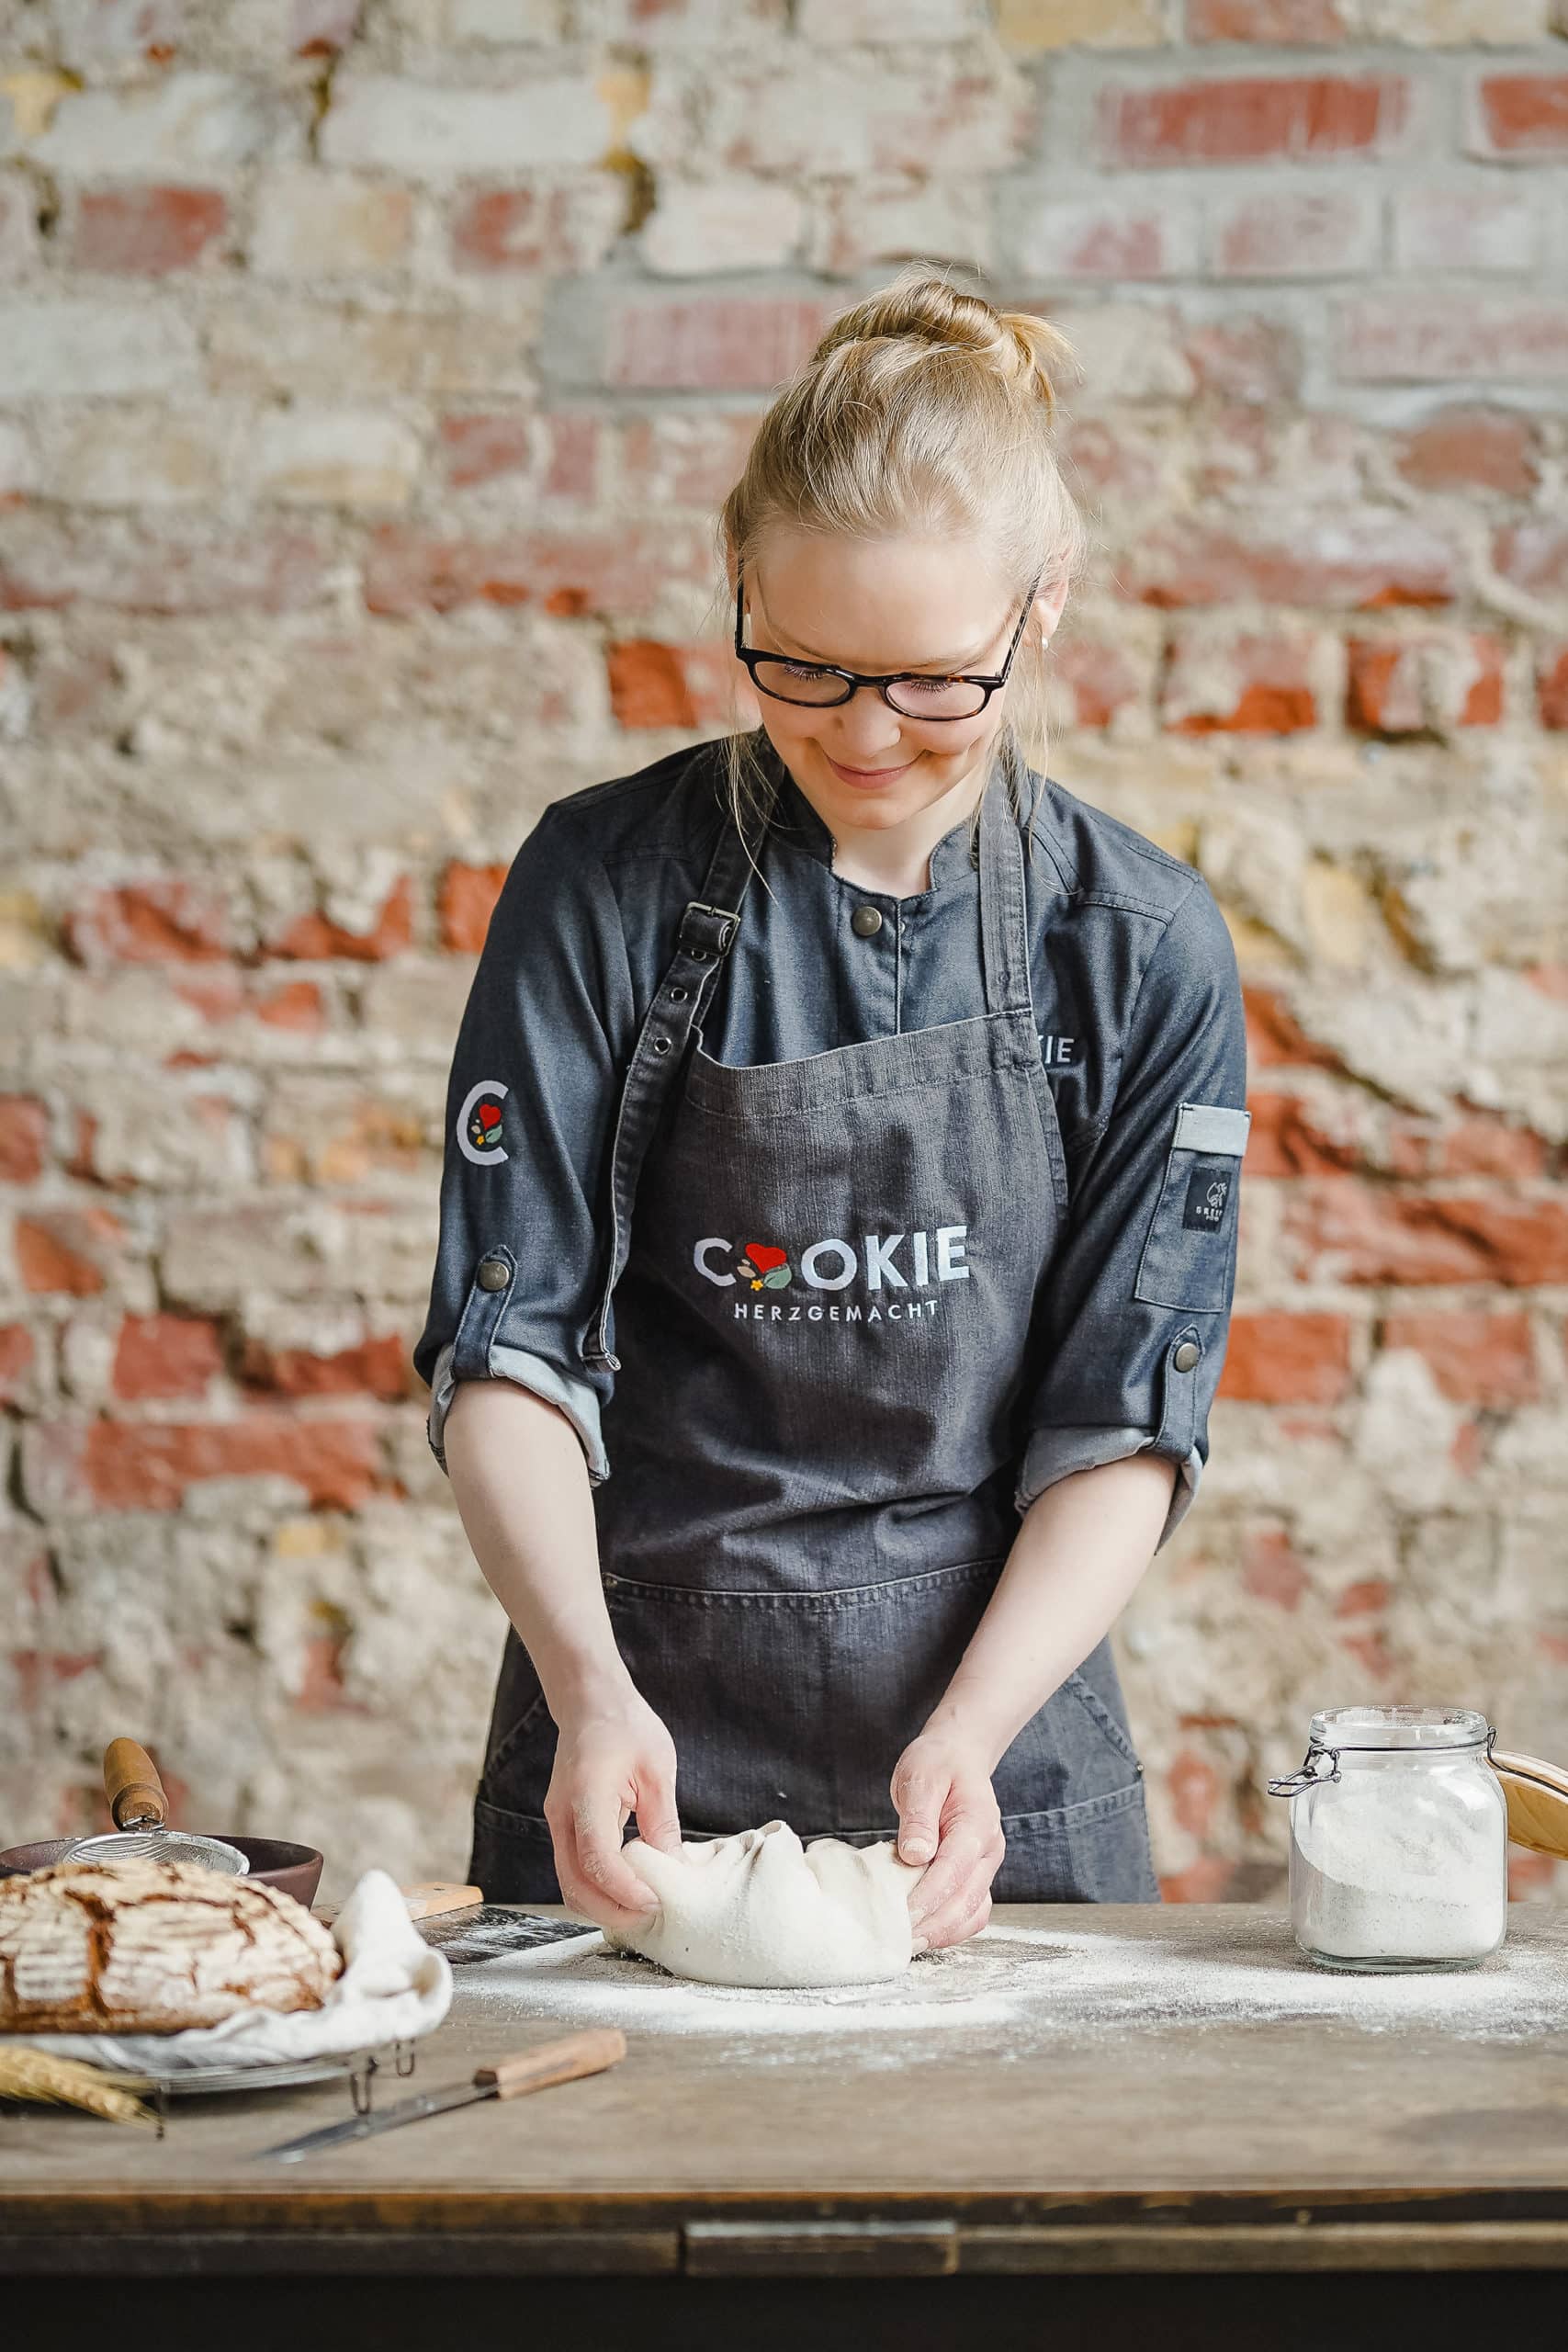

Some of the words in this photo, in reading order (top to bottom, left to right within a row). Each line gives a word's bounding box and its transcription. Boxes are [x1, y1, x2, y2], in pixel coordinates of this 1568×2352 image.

[1037, 1035, 1075, 1064] IE
[456, 1080, 509, 1166] C
[693, 1225, 970, 1291] COKIE
[733, 1299, 938, 1322] HERZGEMACHT
